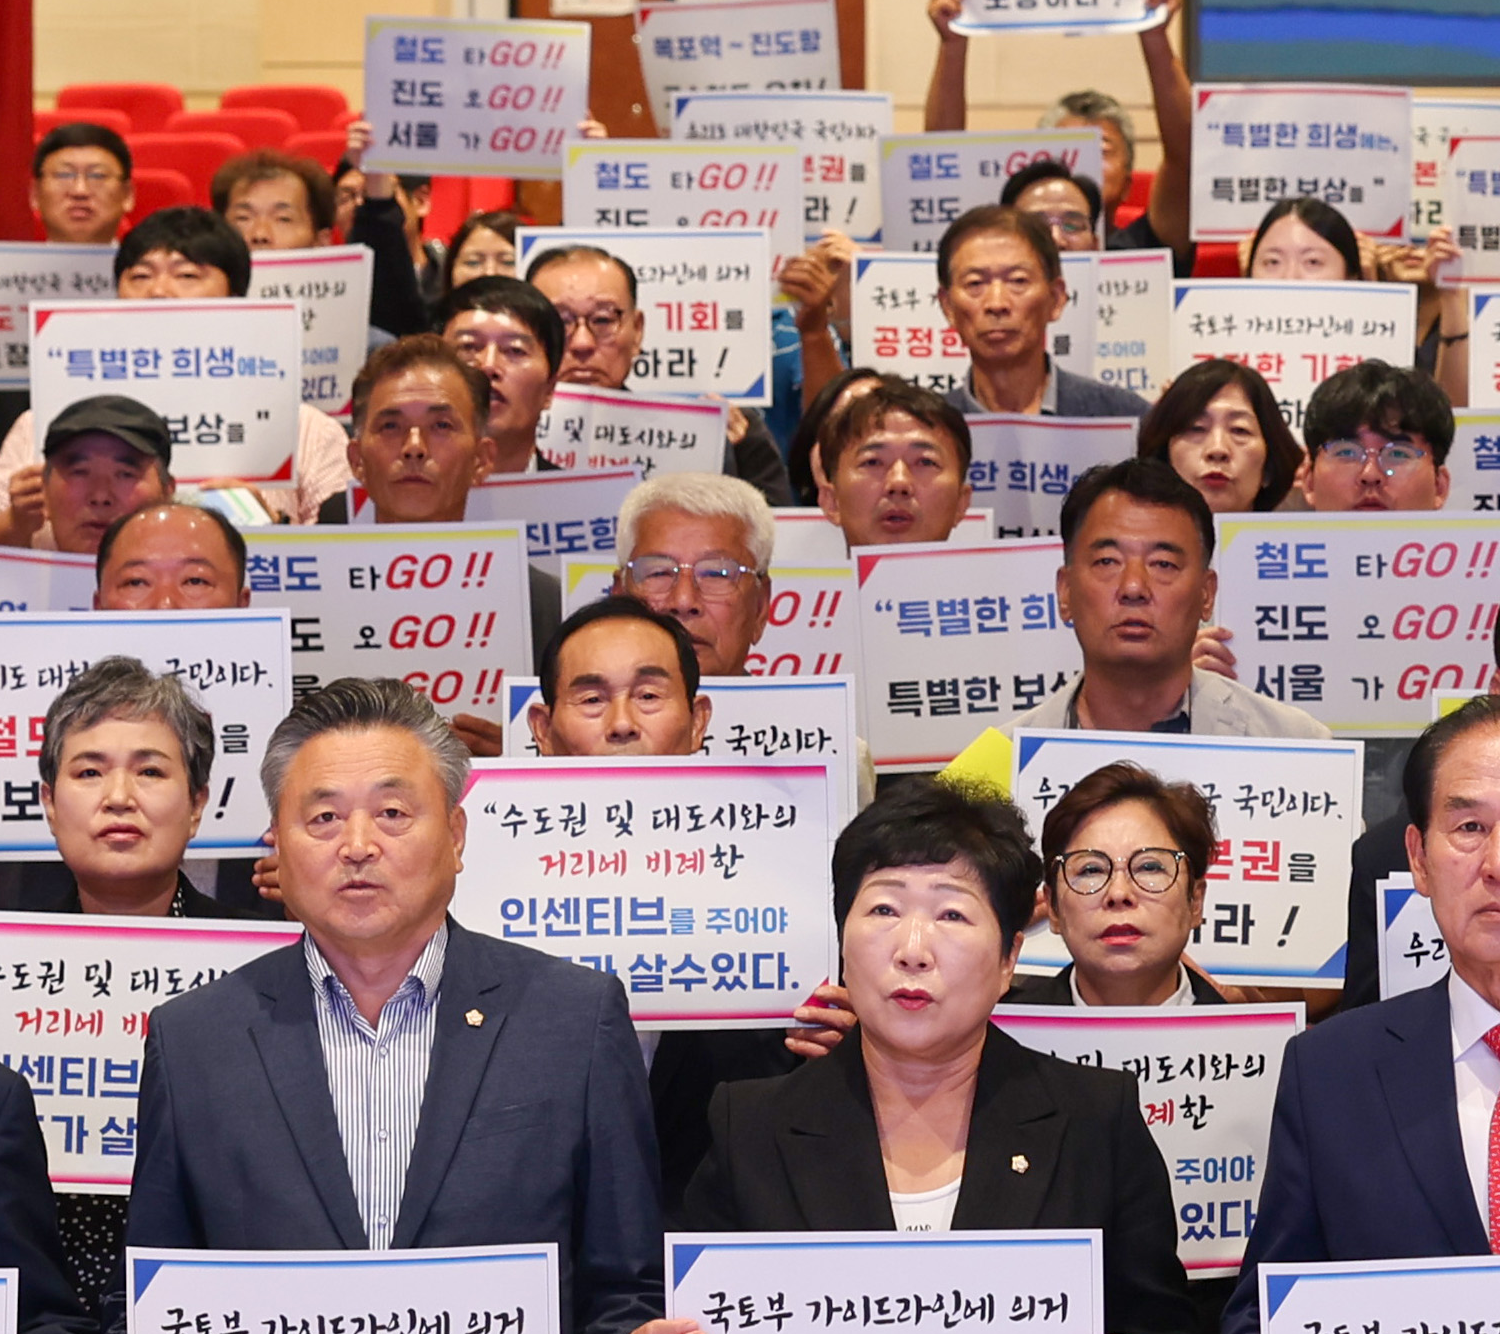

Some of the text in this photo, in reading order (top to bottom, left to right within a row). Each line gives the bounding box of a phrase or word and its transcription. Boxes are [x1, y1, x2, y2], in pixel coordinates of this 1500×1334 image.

[394, 36, 445, 64] 철도
[392, 79, 444, 108] 진도
[388, 122, 439, 149] 서울
[1211, 177, 1363, 207] 특별한 보상을
[656, 301, 744, 331] 기회를
[48, 348, 162, 380] “특별한
[242, 551, 321, 596] 철도
[1255, 542, 1328, 579] 철도
[875, 596, 1010, 637] “특별한
[1255, 605, 1329, 641] 진도
[887, 676, 1001, 717] 특별한
[1255, 665, 1324, 701] 서울
[484, 802, 796, 838] “수도권 및 대도시와의
[1234, 785, 1342, 819] 국민이다.
[539, 843, 744, 879] 거리에 비례한
[501, 897, 788, 938] 인센티브를 주어야
[85, 960, 112, 997] 및
[628, 952, 799, 993] 살수있다.
[15, 1008, 103, 1037] 거리에
[1175, 1155, 1255, 1185] 주어야
